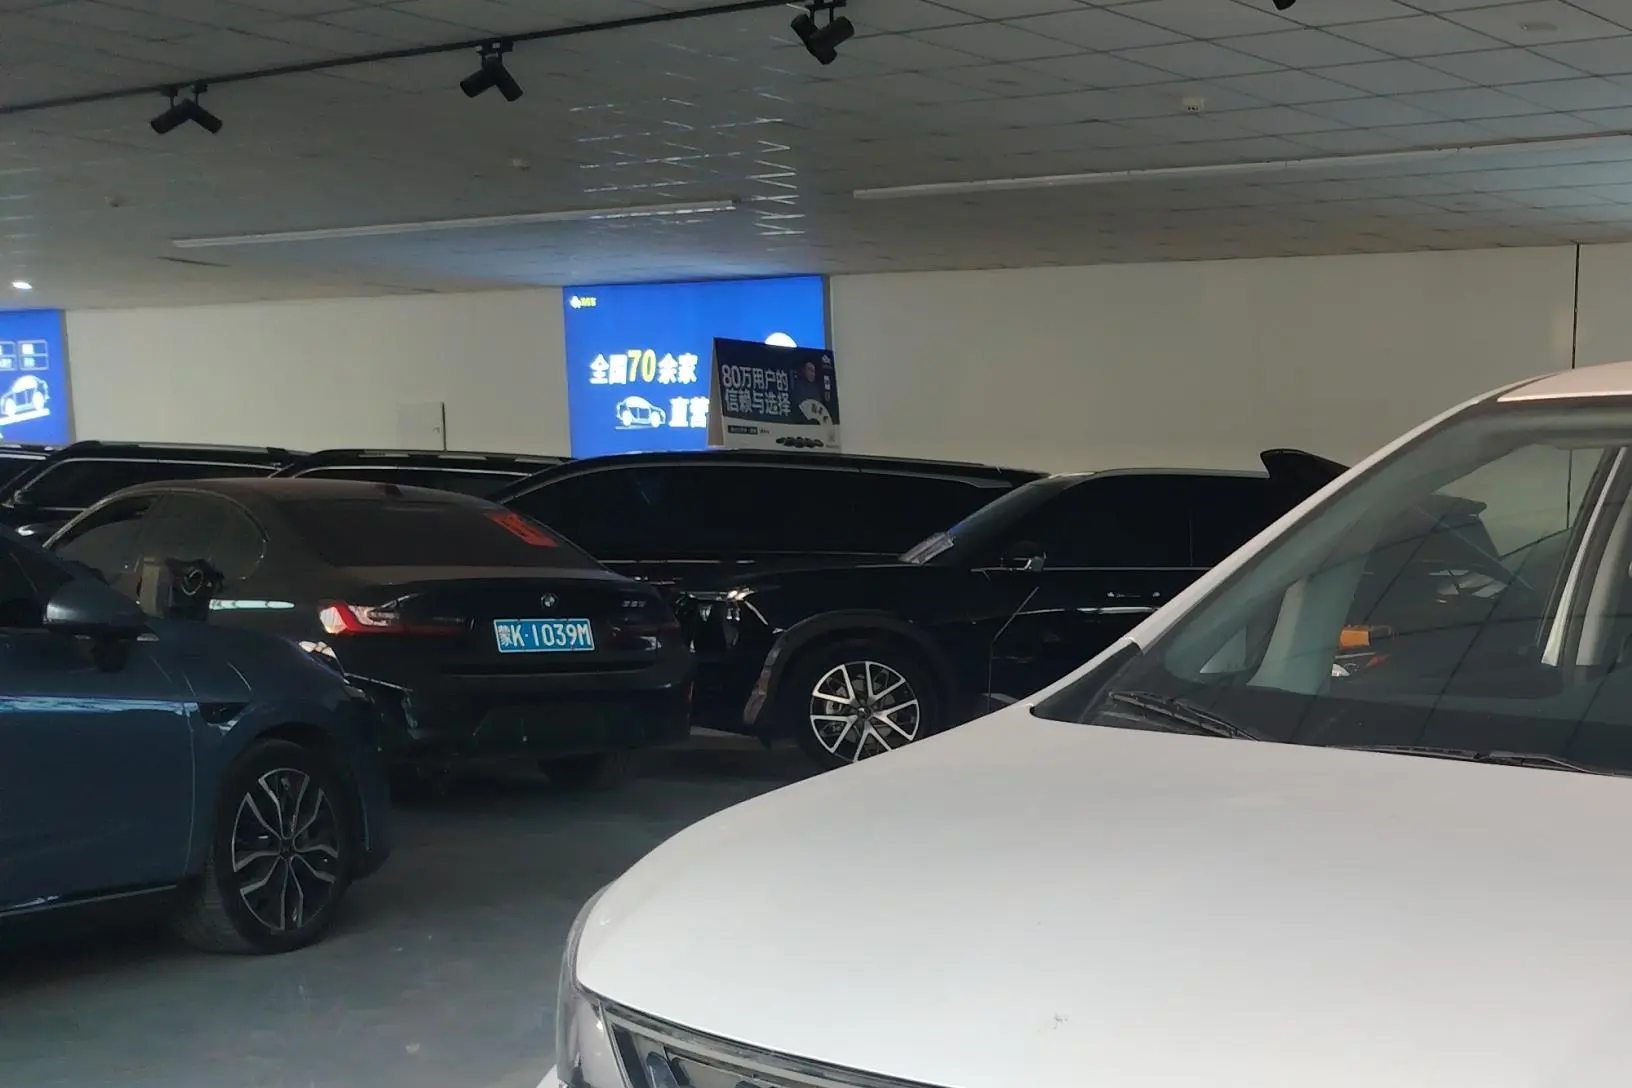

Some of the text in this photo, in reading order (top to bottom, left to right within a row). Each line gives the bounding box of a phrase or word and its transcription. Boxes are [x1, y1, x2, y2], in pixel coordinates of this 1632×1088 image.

[590, 350, 698, 385] 全国70余家
[721, 363, 788, 391] 80万用户的
[724, 389, 791, 416] 信赖与选择
